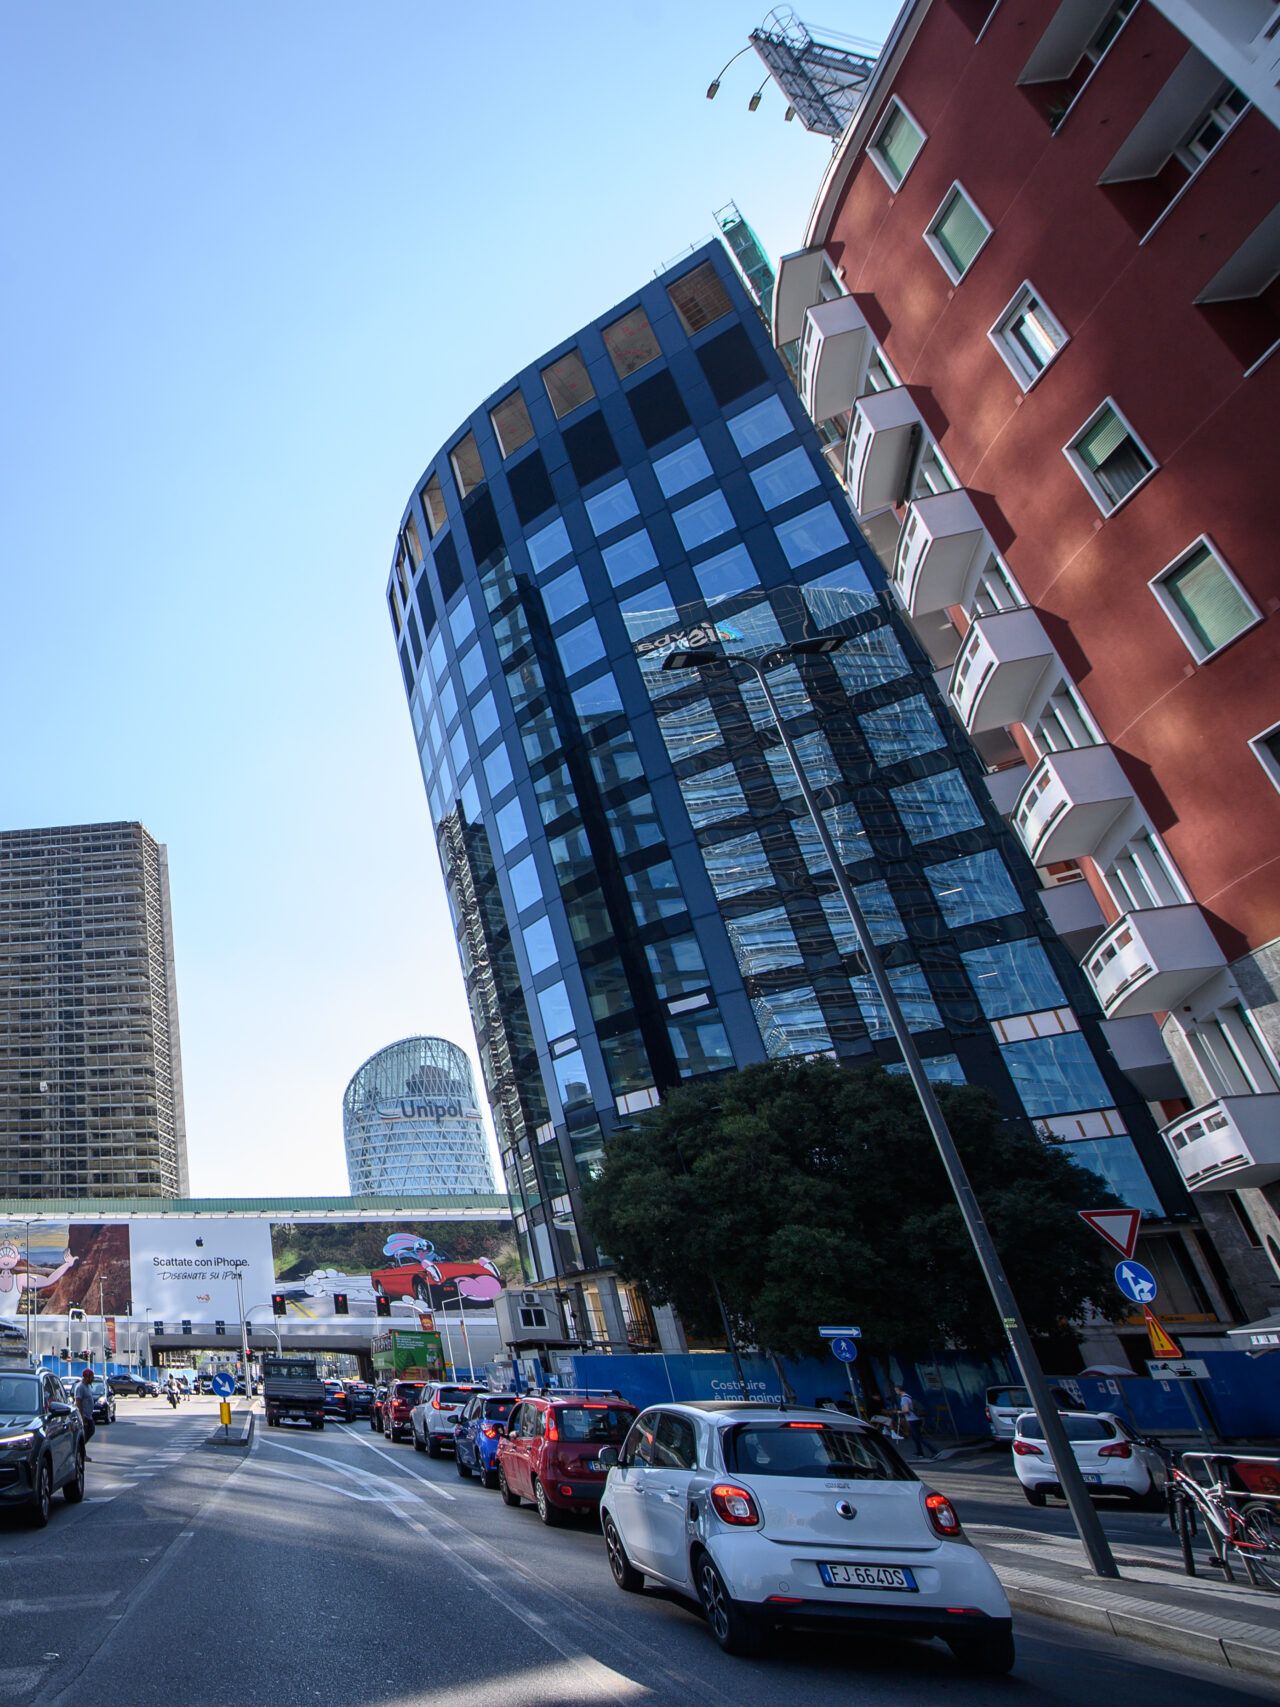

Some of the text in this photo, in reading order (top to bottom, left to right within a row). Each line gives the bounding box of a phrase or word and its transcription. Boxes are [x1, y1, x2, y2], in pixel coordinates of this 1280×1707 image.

[400, 1100, 463, 1123] Unipol
[153, 1256, 250, 1267] Scattate con iPhone.
